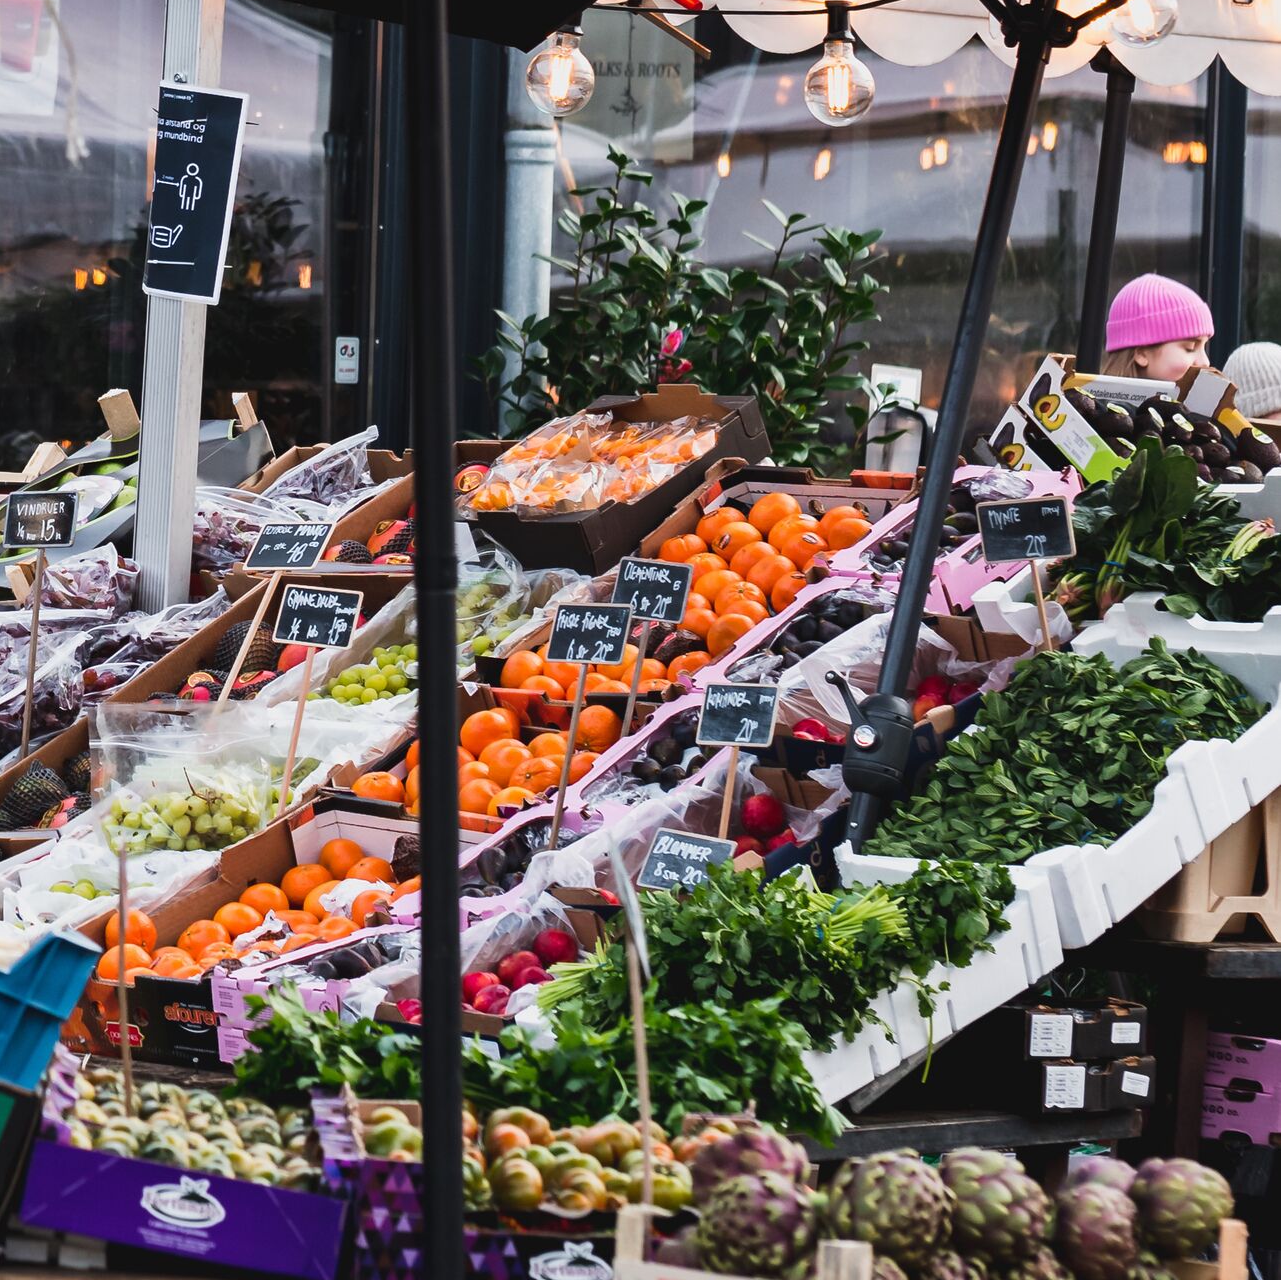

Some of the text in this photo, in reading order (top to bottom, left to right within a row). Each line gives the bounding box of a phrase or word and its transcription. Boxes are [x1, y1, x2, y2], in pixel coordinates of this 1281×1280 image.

[639, 63, 681, 78] ROOTS
[192, 123, 206, 133] og
[164, 131, 204, 144] mundbind
[16, 501, 66, 517] VINDRUER
[988, 507, 1021, 530] MYNTE
[39, 518, 56, 542] 15
[293, 524, 329, 540] MANGO
[652, 835, 712, 862] BLOMMER
[653, 862, 666, 876] 8
